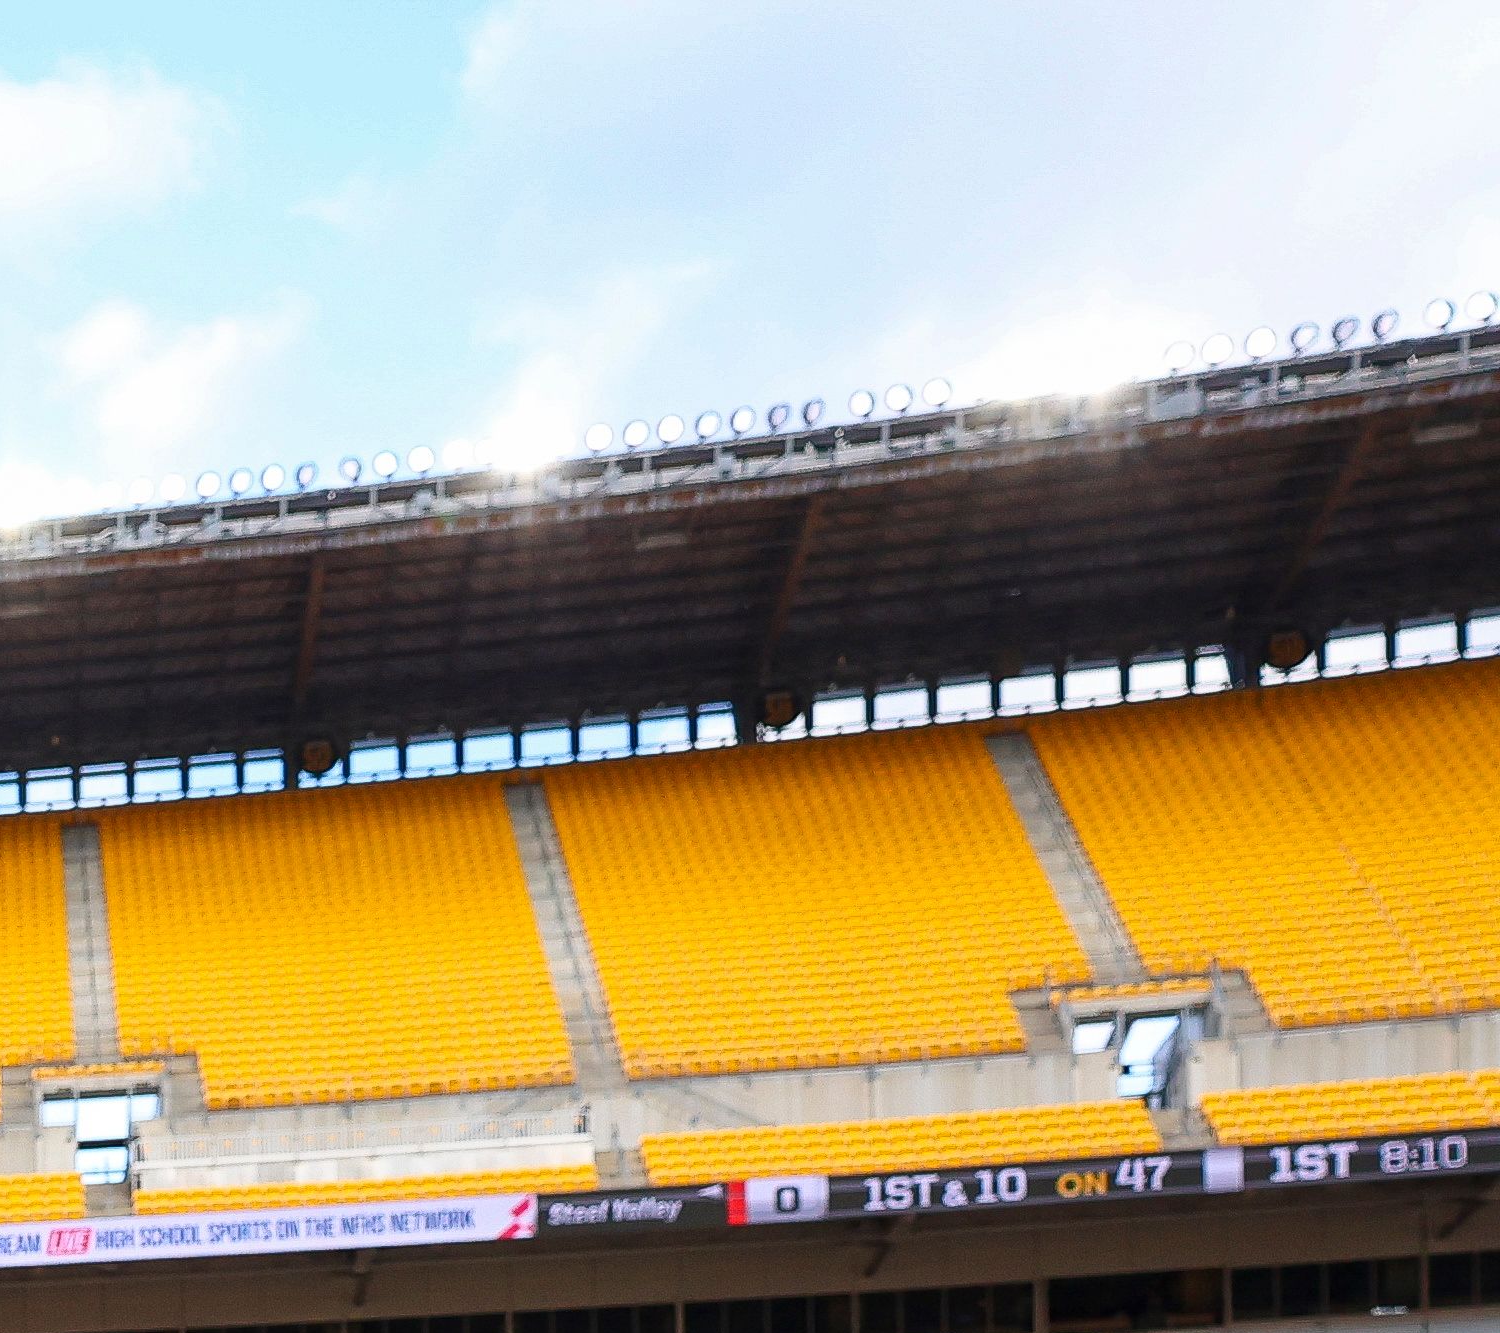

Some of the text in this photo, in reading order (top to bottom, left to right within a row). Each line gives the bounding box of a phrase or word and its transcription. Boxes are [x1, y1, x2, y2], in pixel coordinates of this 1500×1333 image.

[1269, 1134, 1468, 1183] 1ST 8:10
[863, 1156, 1173, 1212] 1ST & 10 ON 47
[95, 1228, 134, 1250] HIGH
[139, 1224, 202, 1247] SCHOOL
[209, 1221, 272, 1244] SPORTS
[277, 1219, 300, 1240] ON
[305, 1215, 333, 1238] THE
[390, 1208, 475, 1233] NETWORK
